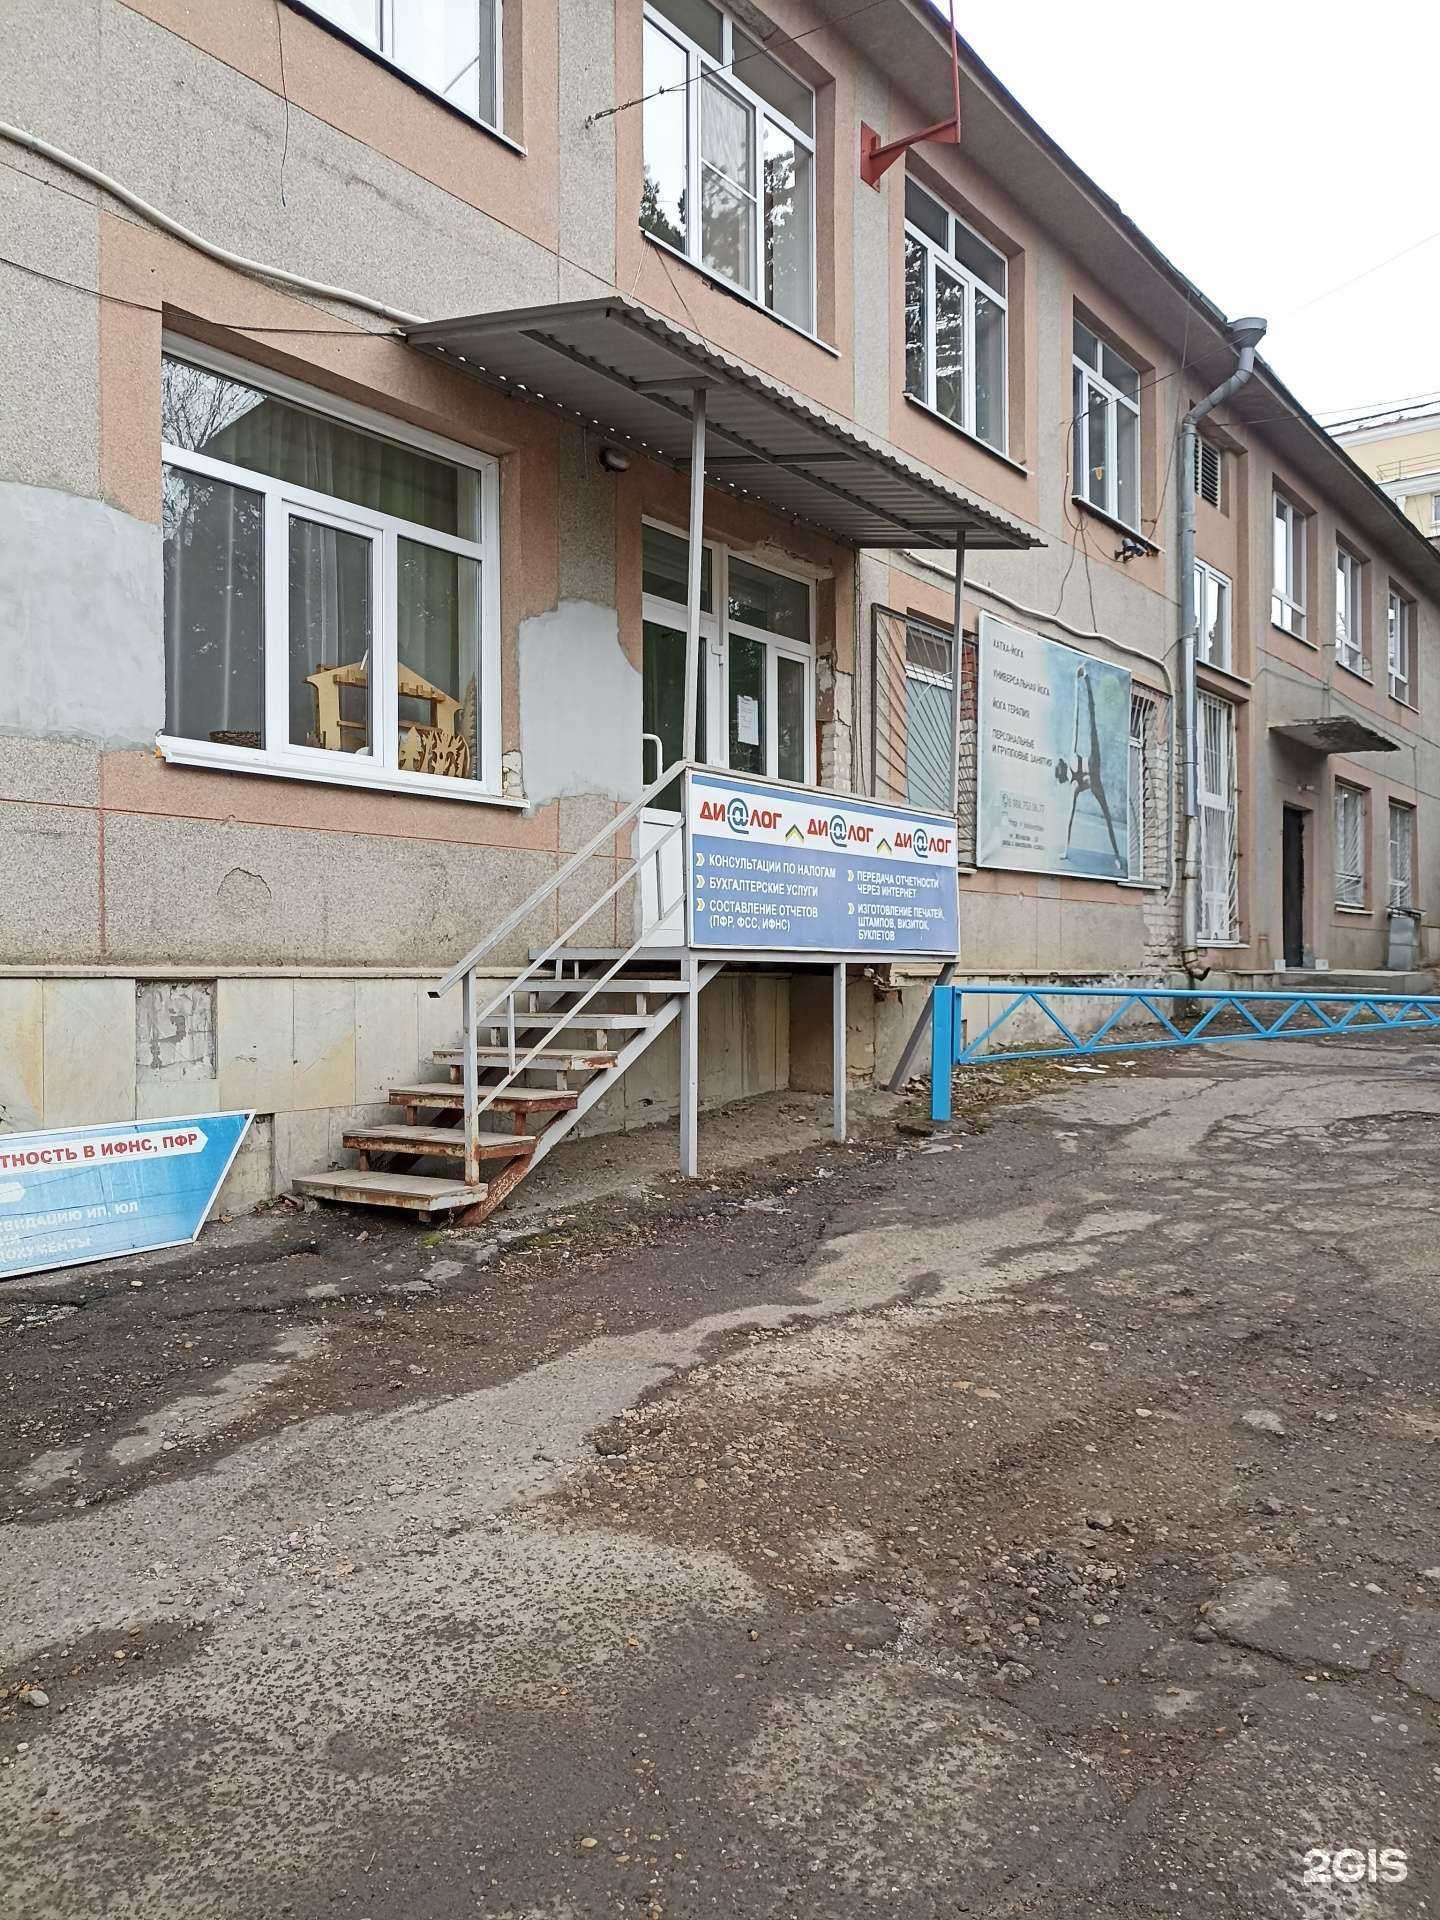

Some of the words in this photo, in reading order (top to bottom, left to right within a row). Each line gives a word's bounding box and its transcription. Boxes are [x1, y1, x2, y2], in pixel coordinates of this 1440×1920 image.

[708, 853, 781, 873] КОНСУЛЬТАЦИИ
[783, 862, 796, 874] ПО
[797, 863, 836, 879] НАЛОГАМ
[709, 876, 785, 895] БУХГАЛТЕРСКИЕ
[786, 884, 819, 897] УСЛУГИ
[857, 870, 894, 885] ПЕРЕДАЧА
[895, 874, 939, 889] ОТЧЕТНОСТИ
[857, 883, 881, 896] ЧЕРЕЗ
[881, 886, 917, 899] ИНТЕРНЕТ
[709, 899, 777, 916] СОСТАВЛЕНИЕ
[779, 905, 818, 918] ОТЧЕТОВ
[857, 903, 912, 917] ИЗГОТОВЛЕНИЕ
[762, 918, 791, 933] ИФНС)
[858, 916, 896, 930] ШТАМПОВ,
[897, 918, 930, 931] ВИЗИТОК,
[858, 929, 896, 942] БУКЛЕТОВ
[83, 1145, 96, 1158] В
[101, 1138, 158, 1156] ИФНС,
[162, 1133, 198, 1149] ПФР
[115, 1201, 139, 1215] ЮЛ
